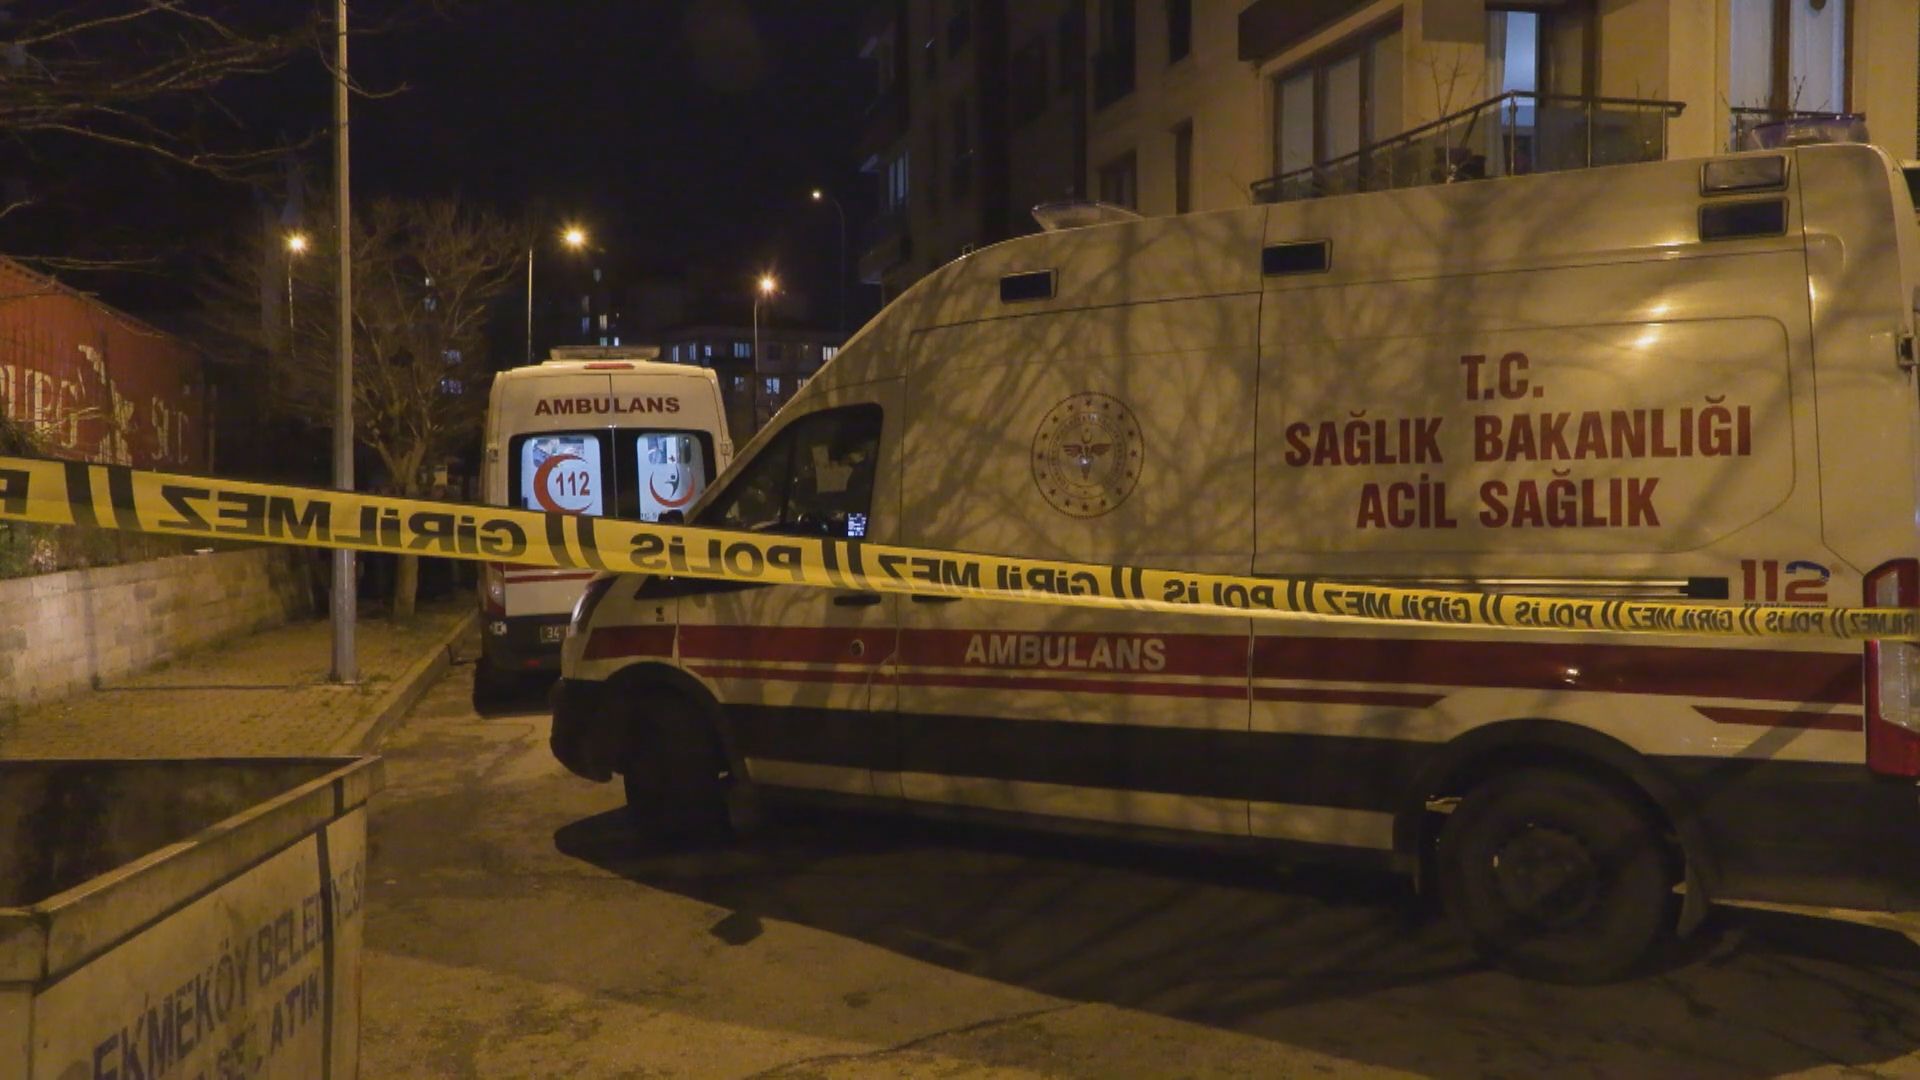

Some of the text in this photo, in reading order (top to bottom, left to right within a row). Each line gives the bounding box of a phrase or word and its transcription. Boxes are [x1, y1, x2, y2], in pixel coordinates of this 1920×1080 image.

[1460, 352, 1544, 401] T.C.
[534, 397, 680, 416] AMBULANS
[1284, 395, 1750, 467] SAĞLIK BAKANLIĞI
[555, 471, 591, 496] 112
[1356, 468, 1660, 529] ACİL SAĞLIK
[1741, 559, 1830, 602] 112
[964, 633, 1166, 672] AMBULANS
